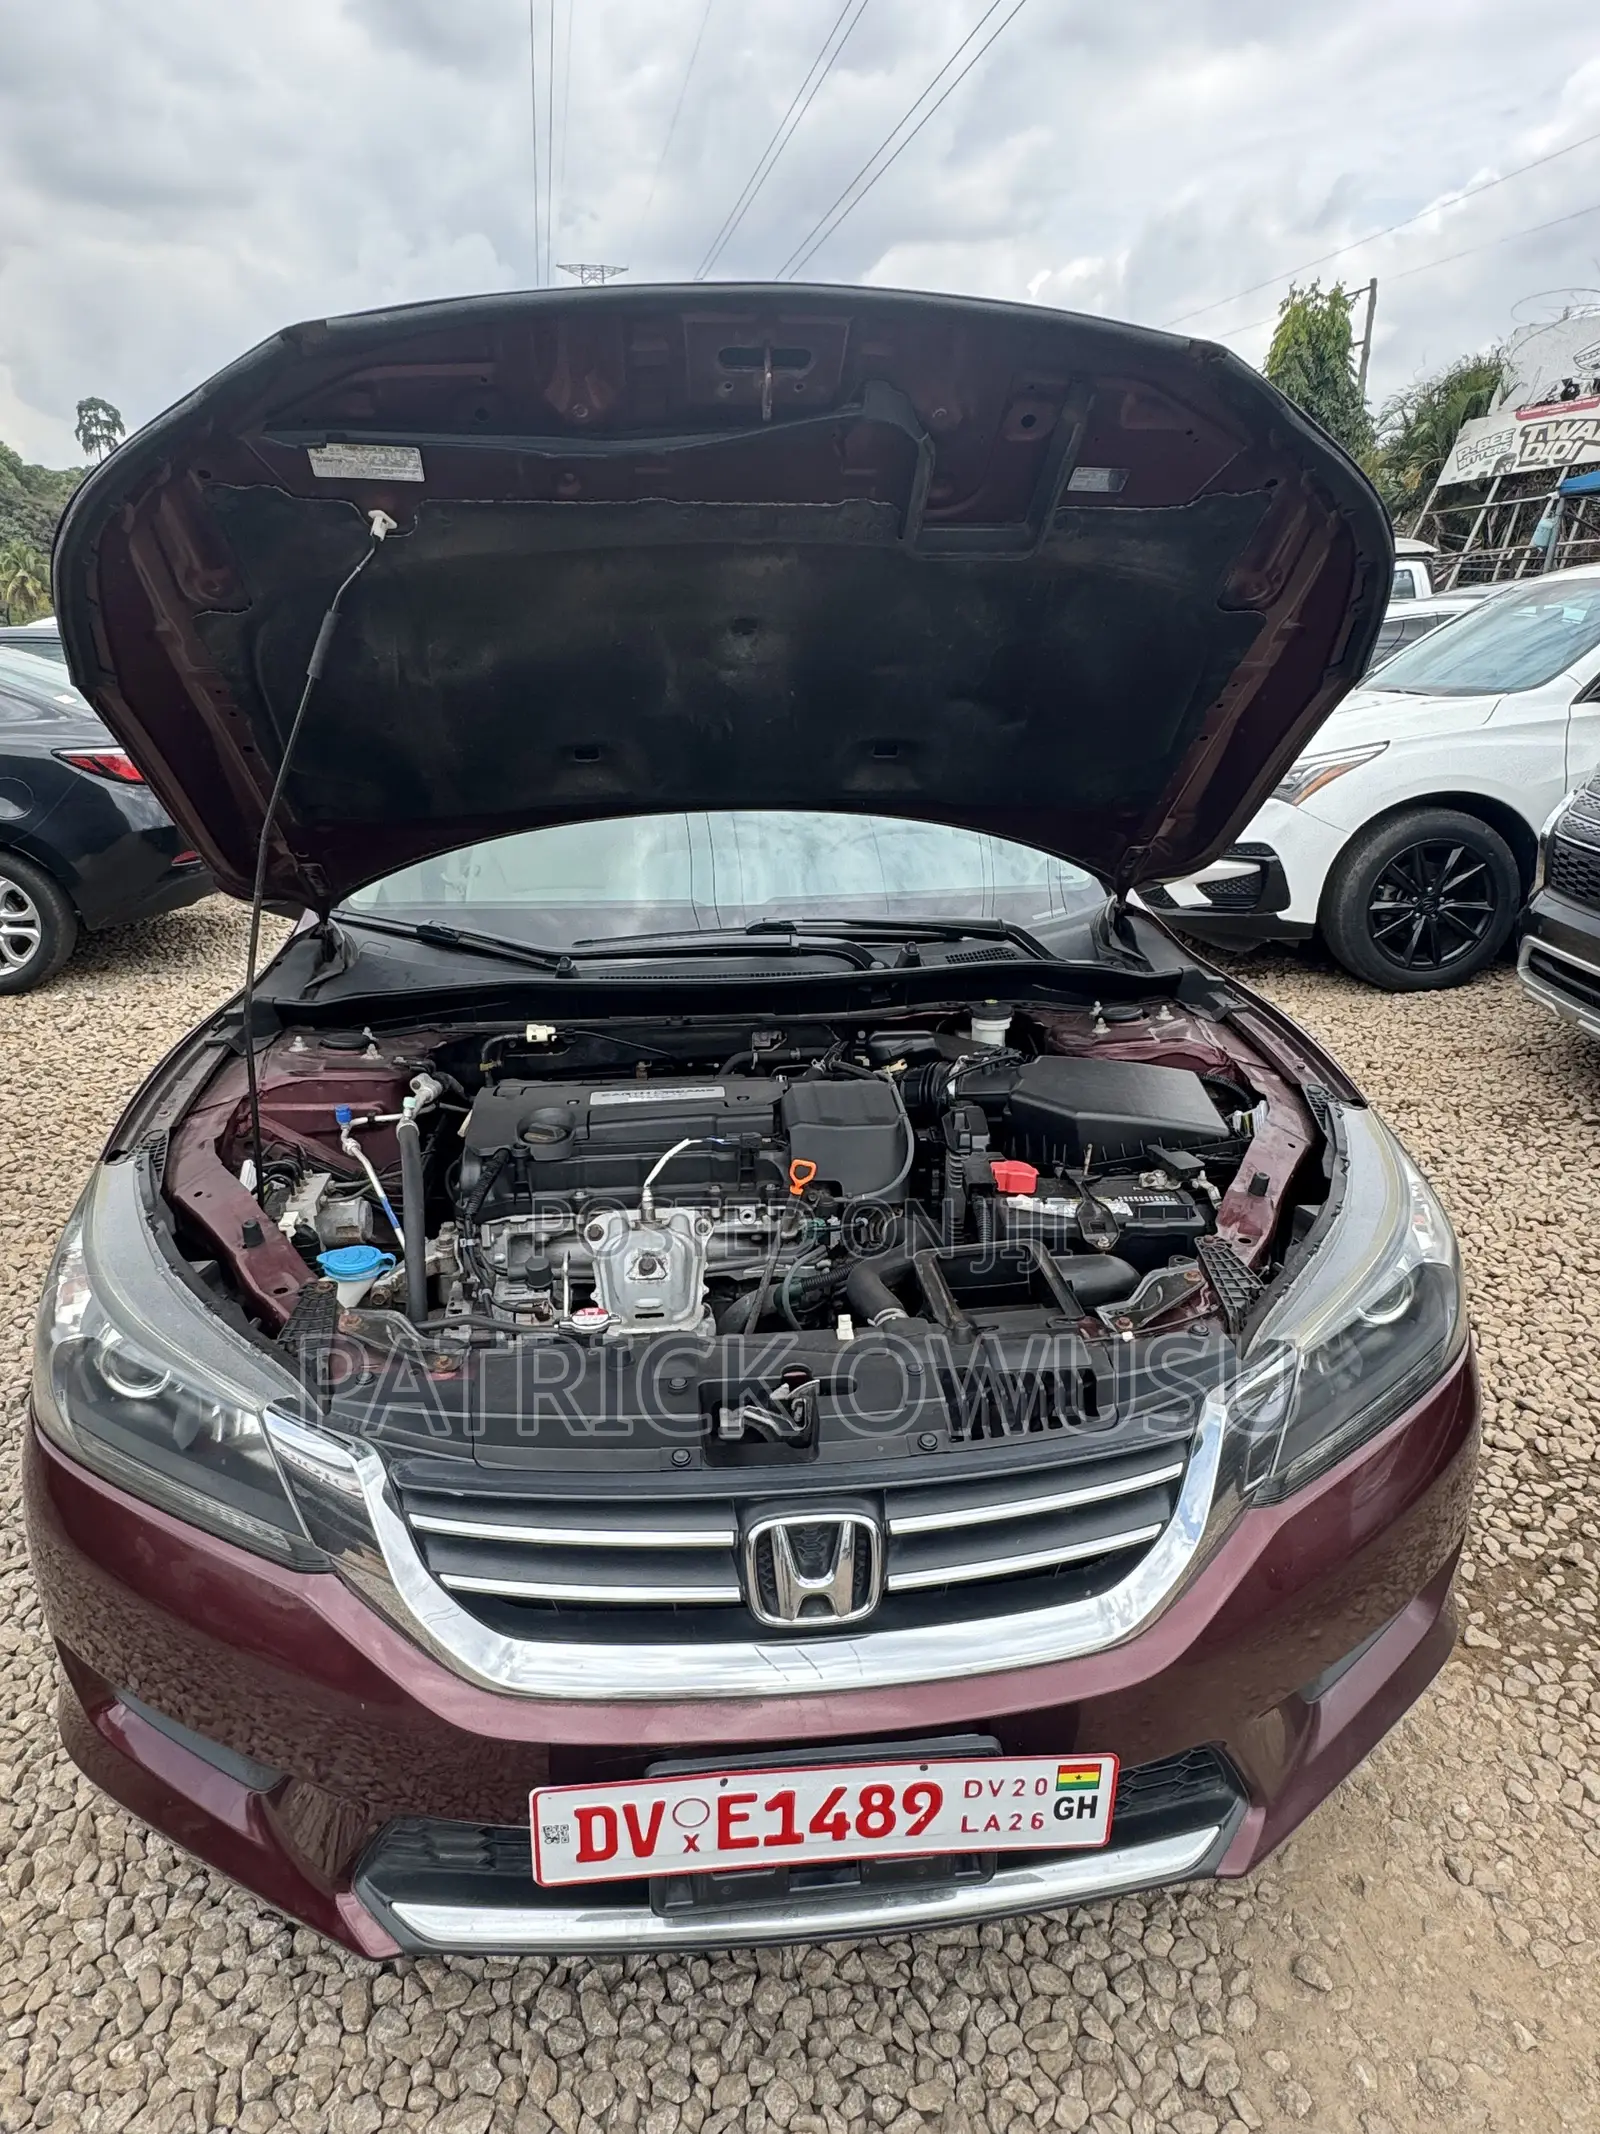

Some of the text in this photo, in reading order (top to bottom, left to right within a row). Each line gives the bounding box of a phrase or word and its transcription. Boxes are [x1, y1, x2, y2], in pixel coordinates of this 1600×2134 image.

[1520, 419, 1600, 444] TWA
[964, 1778, 1048, 1798] DV20
[1053, 1795, 1098, 1820] GH
[573, 1800, 666, 1863] DV
[717, 1781, 943, 1850] E1489
[960, 1812, 1045, 1833] LA26
